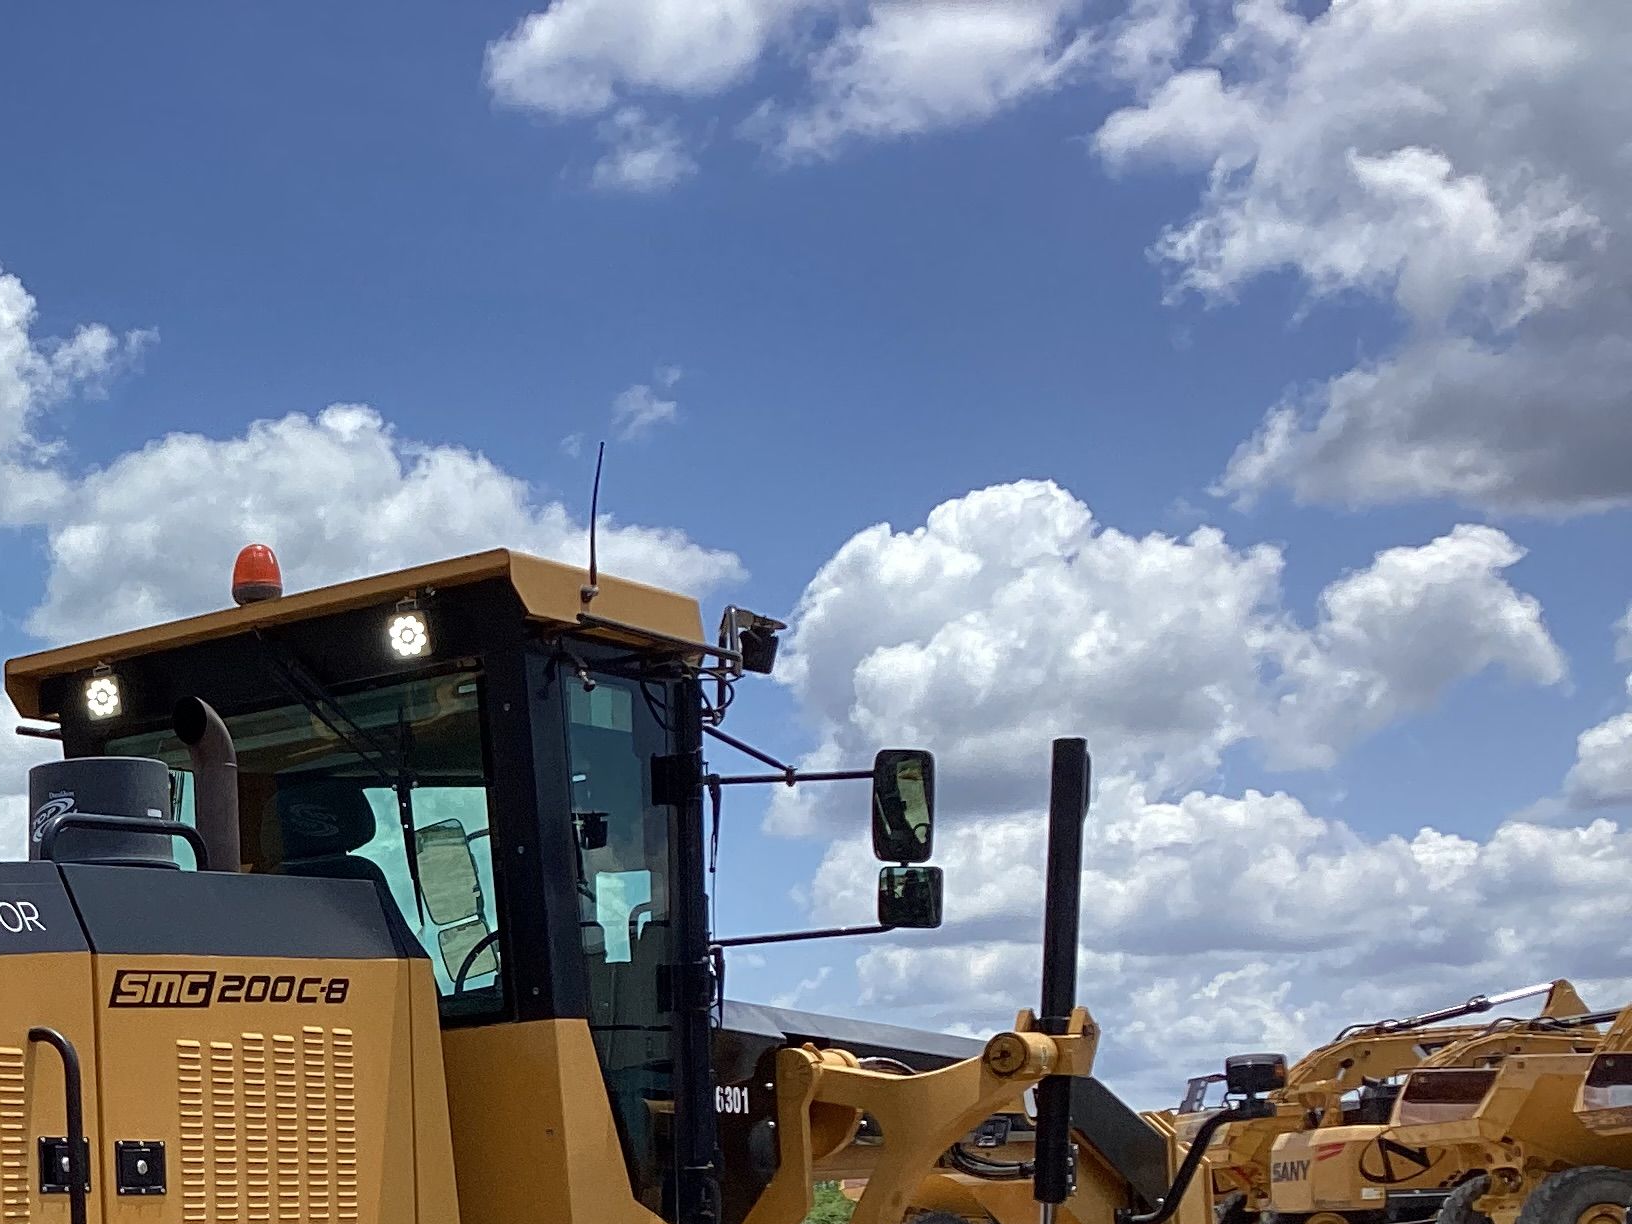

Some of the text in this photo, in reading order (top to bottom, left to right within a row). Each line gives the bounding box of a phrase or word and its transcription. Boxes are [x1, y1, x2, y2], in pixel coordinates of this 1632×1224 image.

[115, 973, 350, 1004] SMG 200C-8
[715, 1086, 749, 1114] 6301
[1272, 1160, 1310, 1183] SANY
